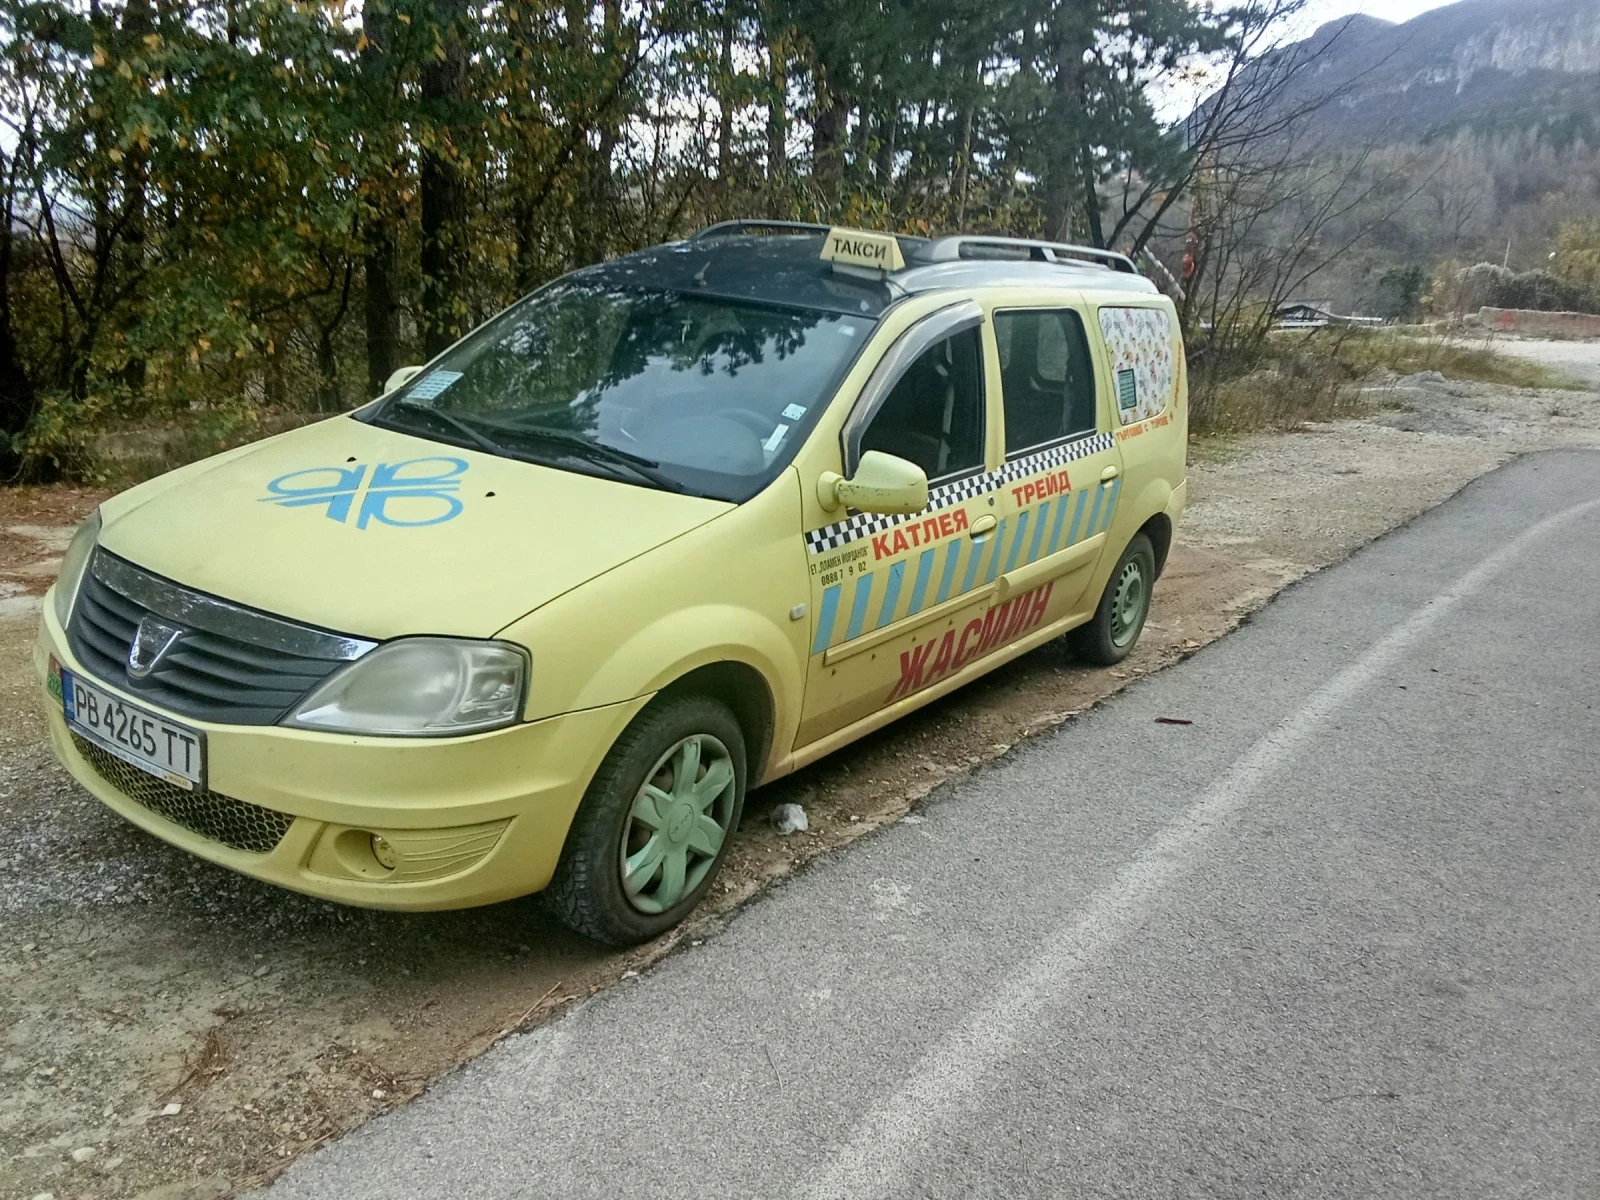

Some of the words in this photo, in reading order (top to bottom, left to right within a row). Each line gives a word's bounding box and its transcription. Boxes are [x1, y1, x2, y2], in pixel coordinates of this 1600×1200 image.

[832, 237, 887, 261] ТАКСИ
[871, 507, 970, 561] КАТЛЕЯ
[1011, 470, 1072, 508] ТРЕЙД
[821, 571, 839, 586] 0888
[858, 561, 866, 572] 02
[883, 579, 1056, 705] ЖАСМИН
[103, 701, 157, 757] 4265
[161, 726, 196, 774] TT
